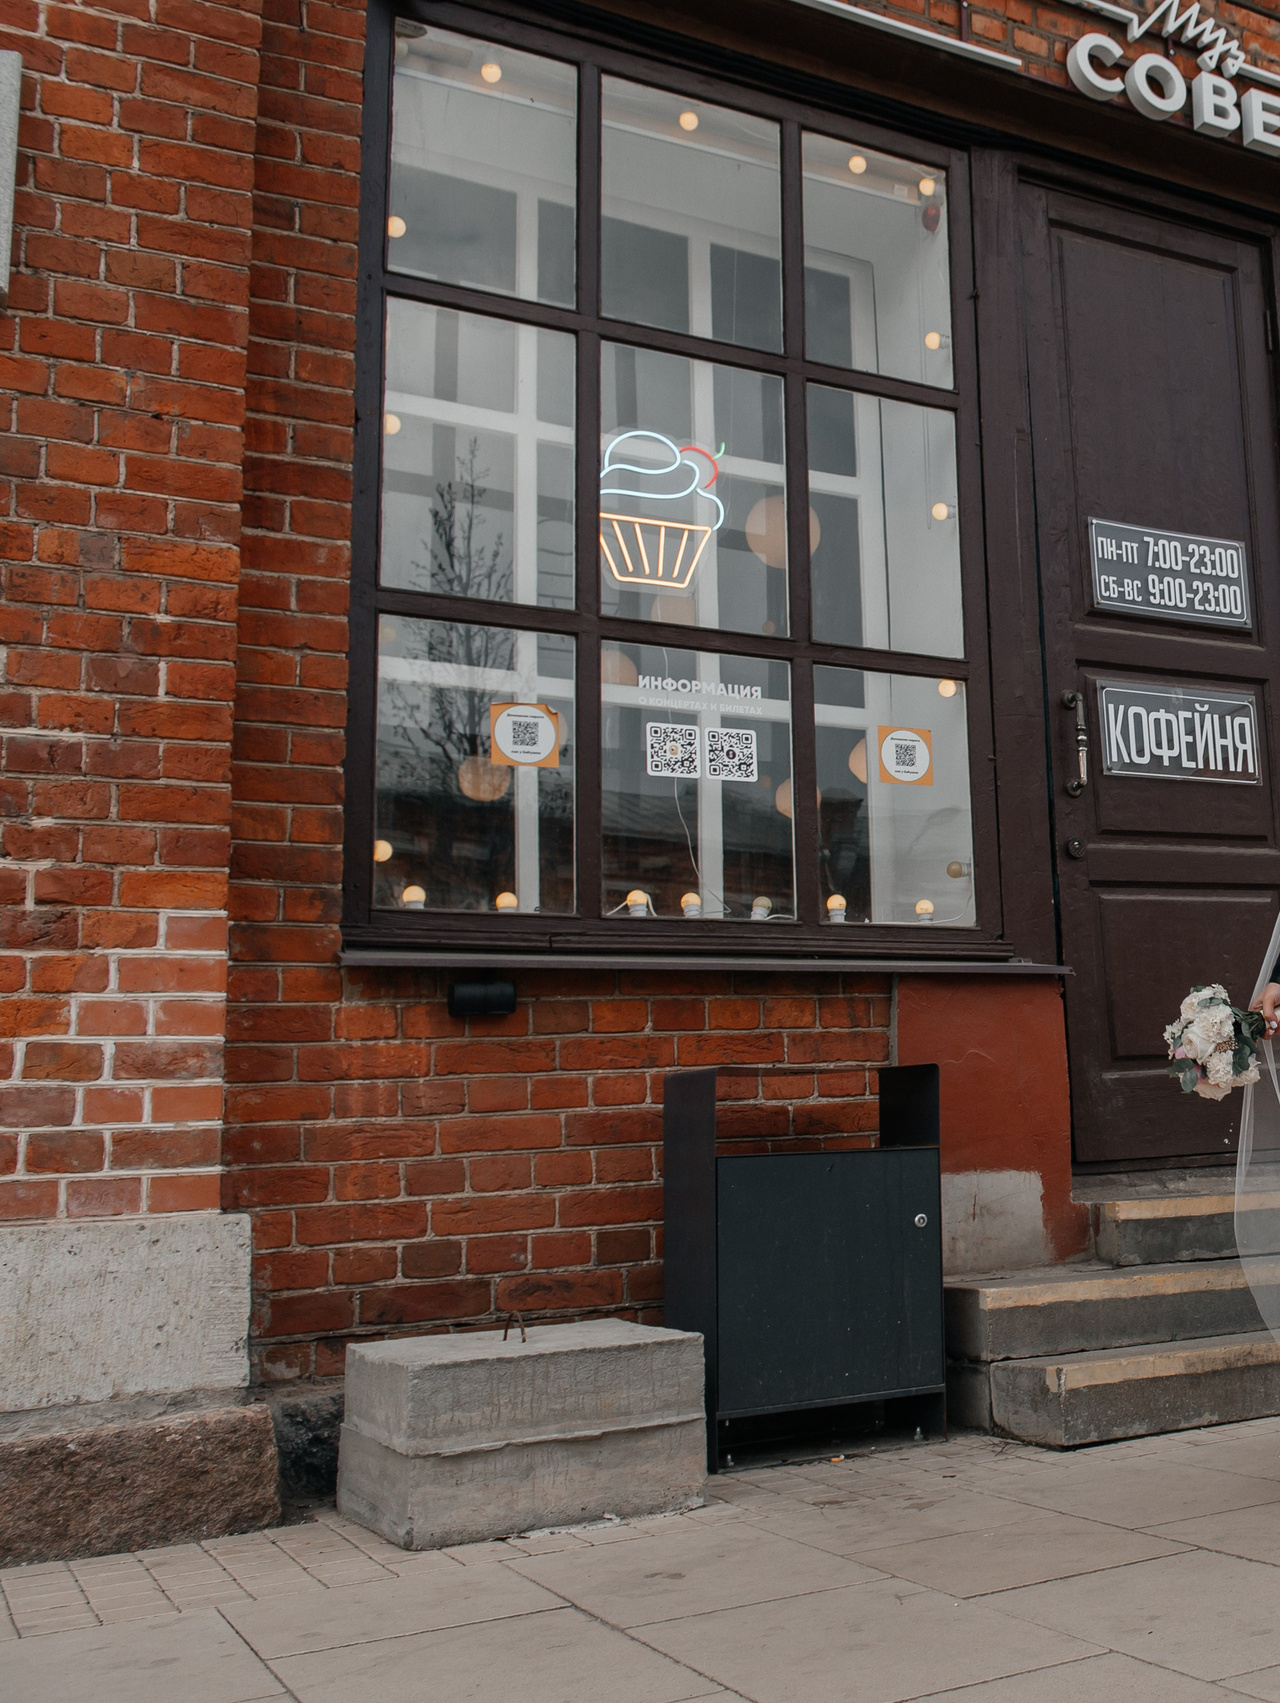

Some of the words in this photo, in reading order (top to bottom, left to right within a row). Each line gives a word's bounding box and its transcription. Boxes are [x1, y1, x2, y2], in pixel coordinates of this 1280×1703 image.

[1097, 536, 1139, 564] ПН-ПТ
[1143, 536, 1239, 578] 7:00-23:00
[1100, 575, 1142, 602] СБ-ВС
[1148, 574, 1242, 615] 9:00-23:00
[638, 674, 762, 700] ИНФОРМАЦИЯ
[650, 697, 709, 711] КОНЦЕРТАХ
[720, 703, 763, 715] БИЛЕТАХ
[1108, 703, 1255, 773] КОФЕЙНЯ
